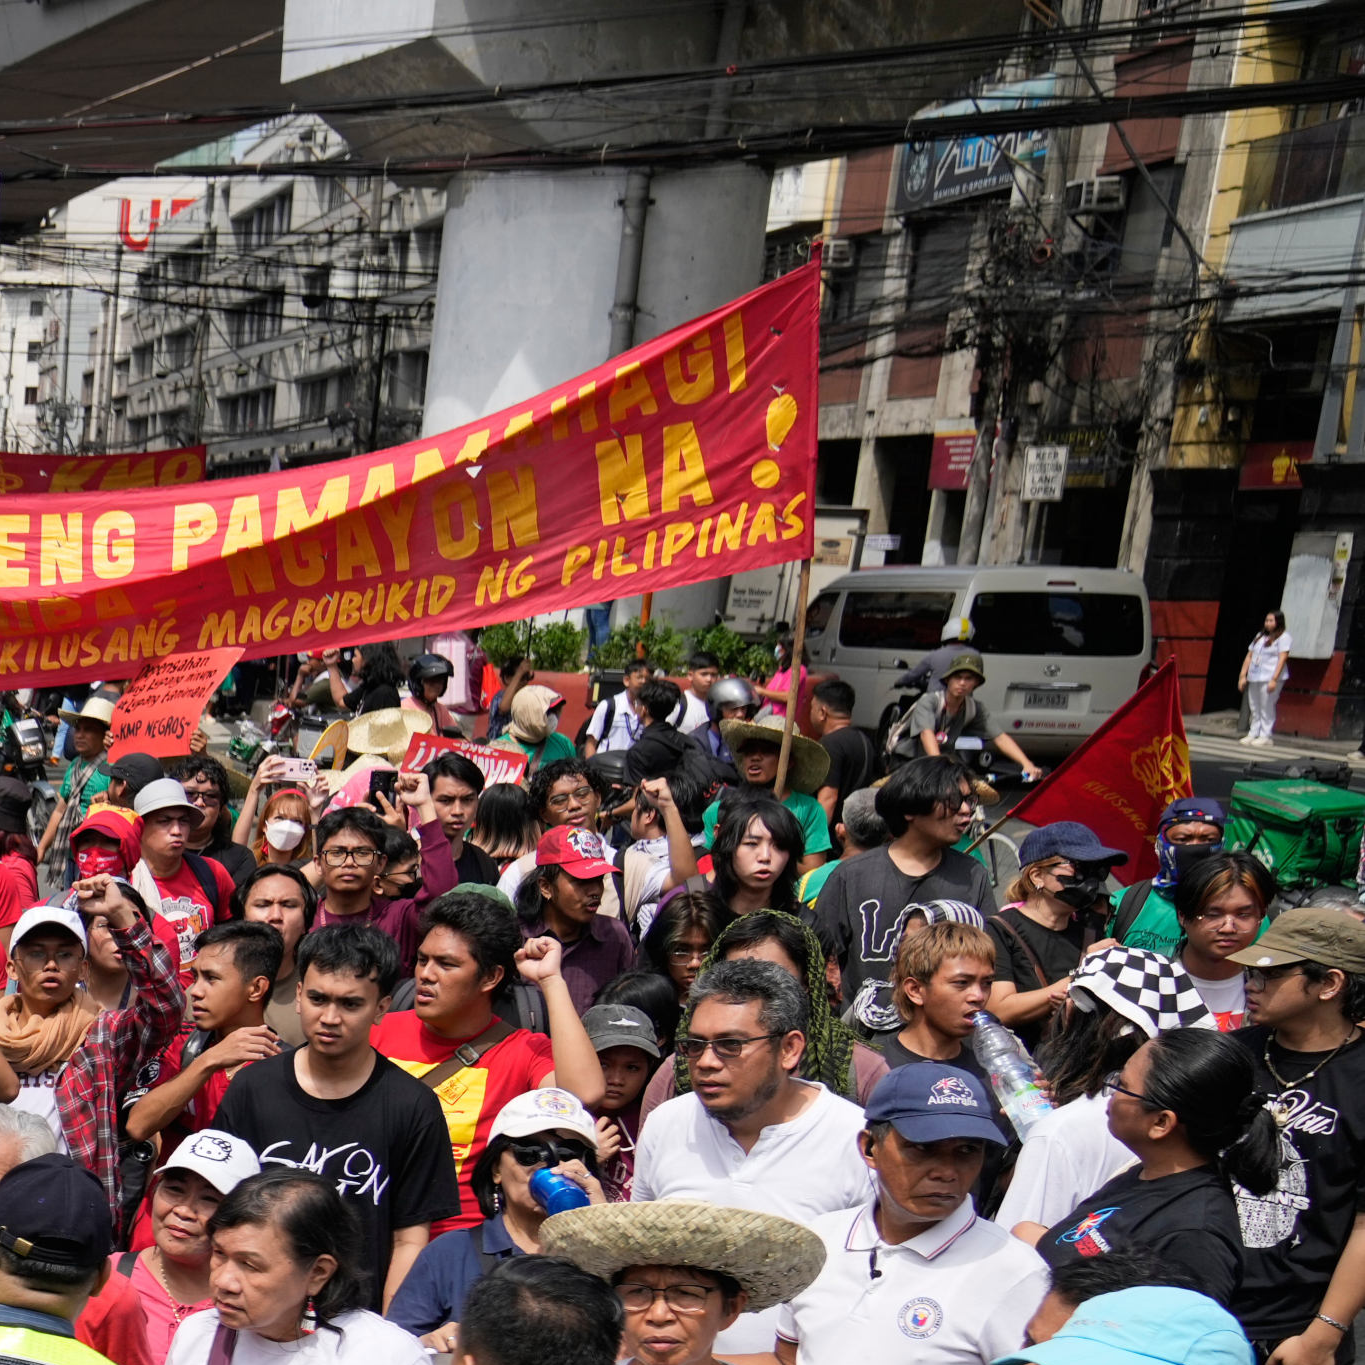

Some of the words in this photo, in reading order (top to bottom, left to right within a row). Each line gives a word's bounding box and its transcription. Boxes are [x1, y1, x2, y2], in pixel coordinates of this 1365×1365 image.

[1036, 451, 1060, 461] KEEP
[1030, 486, 1057, 497] OPEN
[197, 575, 457, 650] MAGBUBUKID
[475, 555, 537, 607] NG
[560, 491, 807, 586] PILIPINAS
[1082, 781, 1147, 831] KILUSANG
[927, 1095, 979, 1107] Australia
